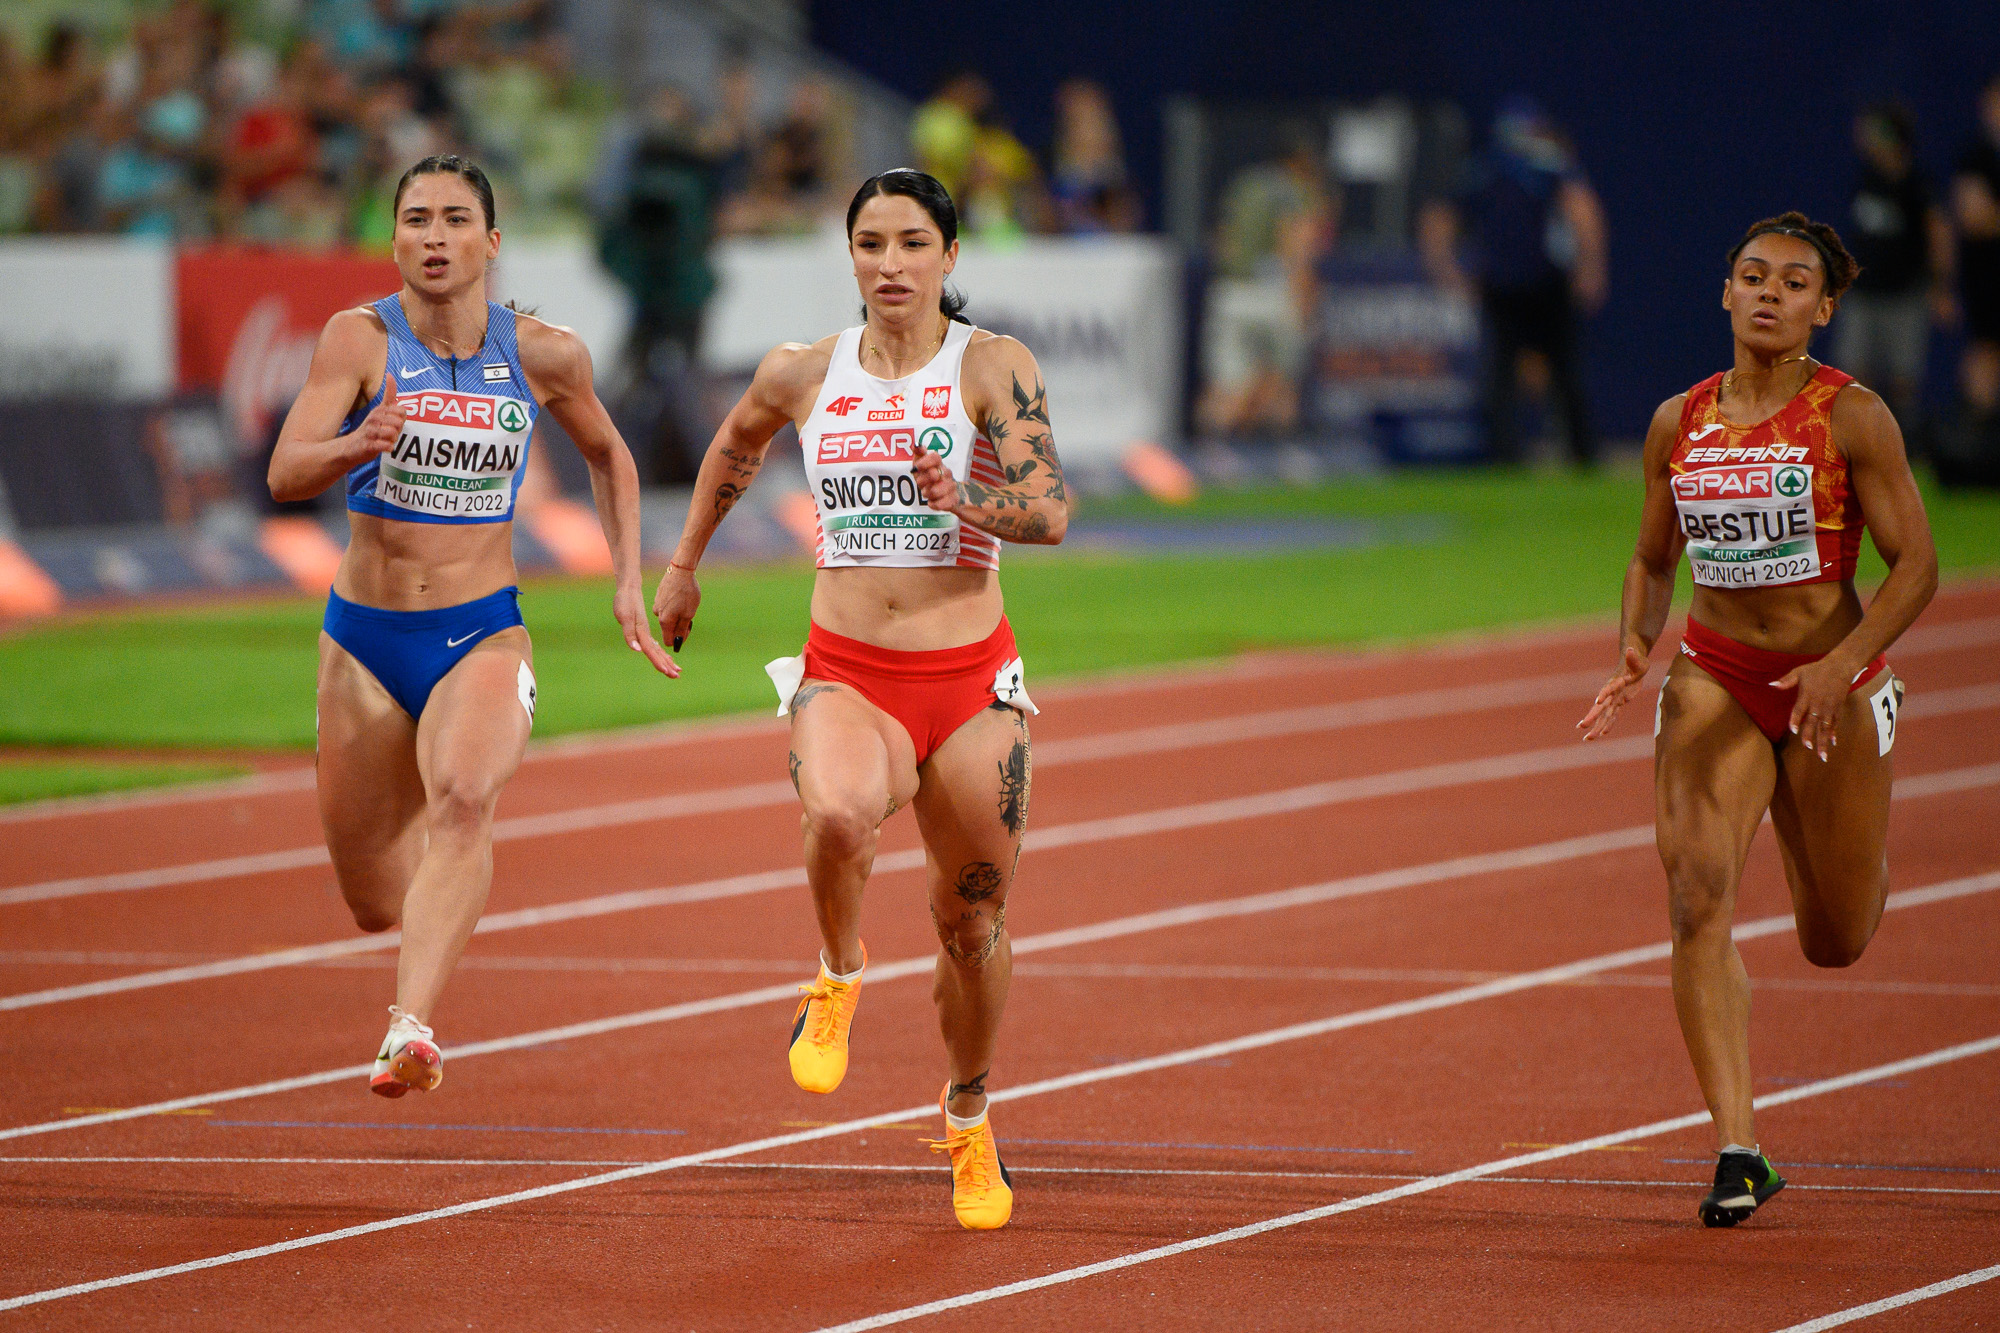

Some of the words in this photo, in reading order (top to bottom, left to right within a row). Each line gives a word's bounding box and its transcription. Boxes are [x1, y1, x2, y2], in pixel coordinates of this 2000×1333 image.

[397, 395, 492, 425] SPAR
[869, 411, 903, 421] ORLEN
[390, 433, 519, 473] VAISMAN
[820, 432, 914, 460] SPAR
[1683, 443, 1810, 463] ESPAÑA
[408, 474, 413, 483] I
[416, 475, 444, 487] RUN
[1676, 470, 1770, 496] SPAR
[384, 481, 459, 511] MUNICH
[464, 494, 503, 512] 2022
[851, 516, 884, 527] RUN
[1683, 503, 1809, 542] BESTUÉ
[904, 532, 951, 550] 2022
[1714, 550, 1738, 561] RUN
[1696, 562, 1757, 583] MUNICH
[1763, 557, 1811, 581] 2022
